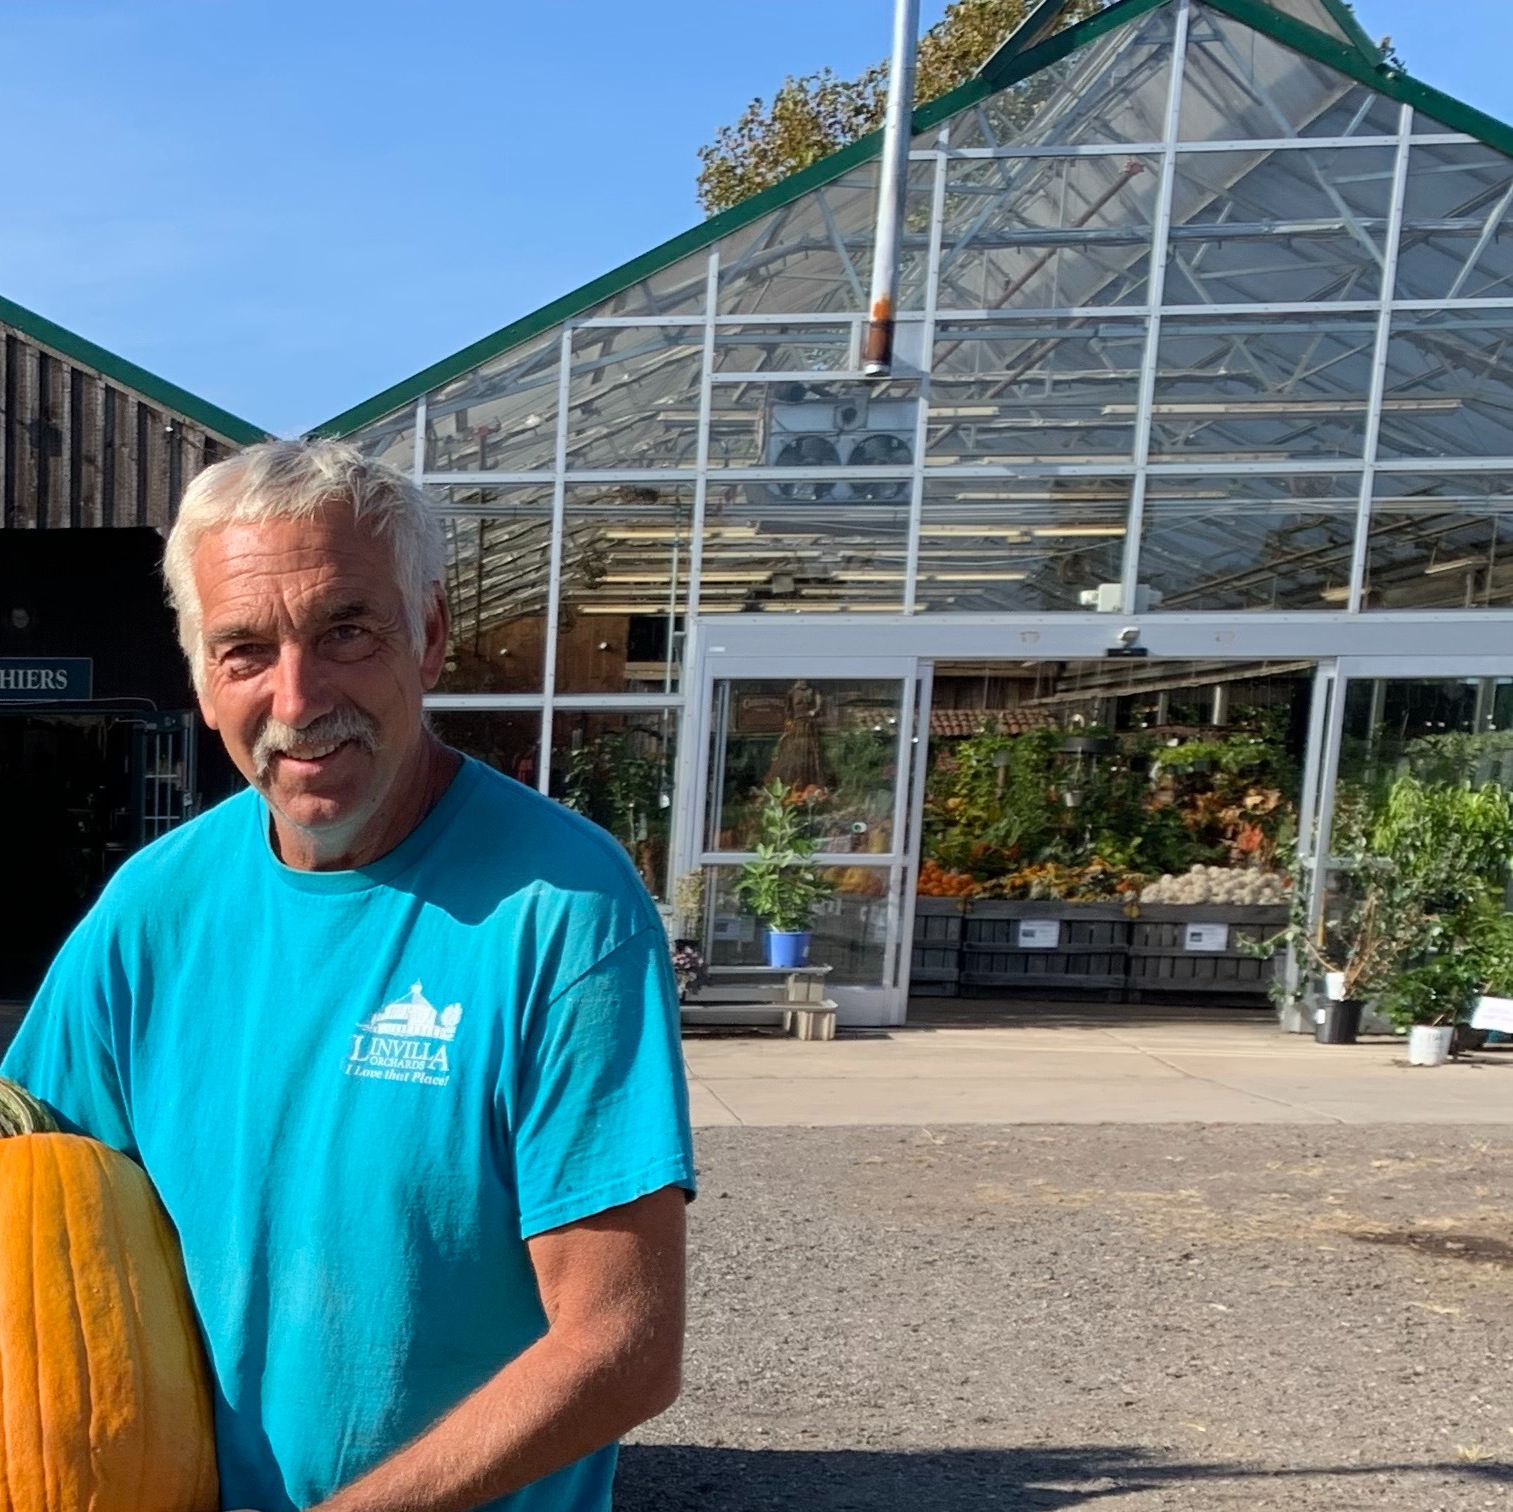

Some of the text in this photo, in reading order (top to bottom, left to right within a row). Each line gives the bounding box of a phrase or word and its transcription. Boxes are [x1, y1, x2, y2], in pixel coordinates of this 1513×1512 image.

[349, 1034, 450, 1072] LINVILLA
[369, 1055, 426, 1070] ORCHARDS
[354, 1065, 384, 1079] Love
[384, 1068, 410, 1082] that
